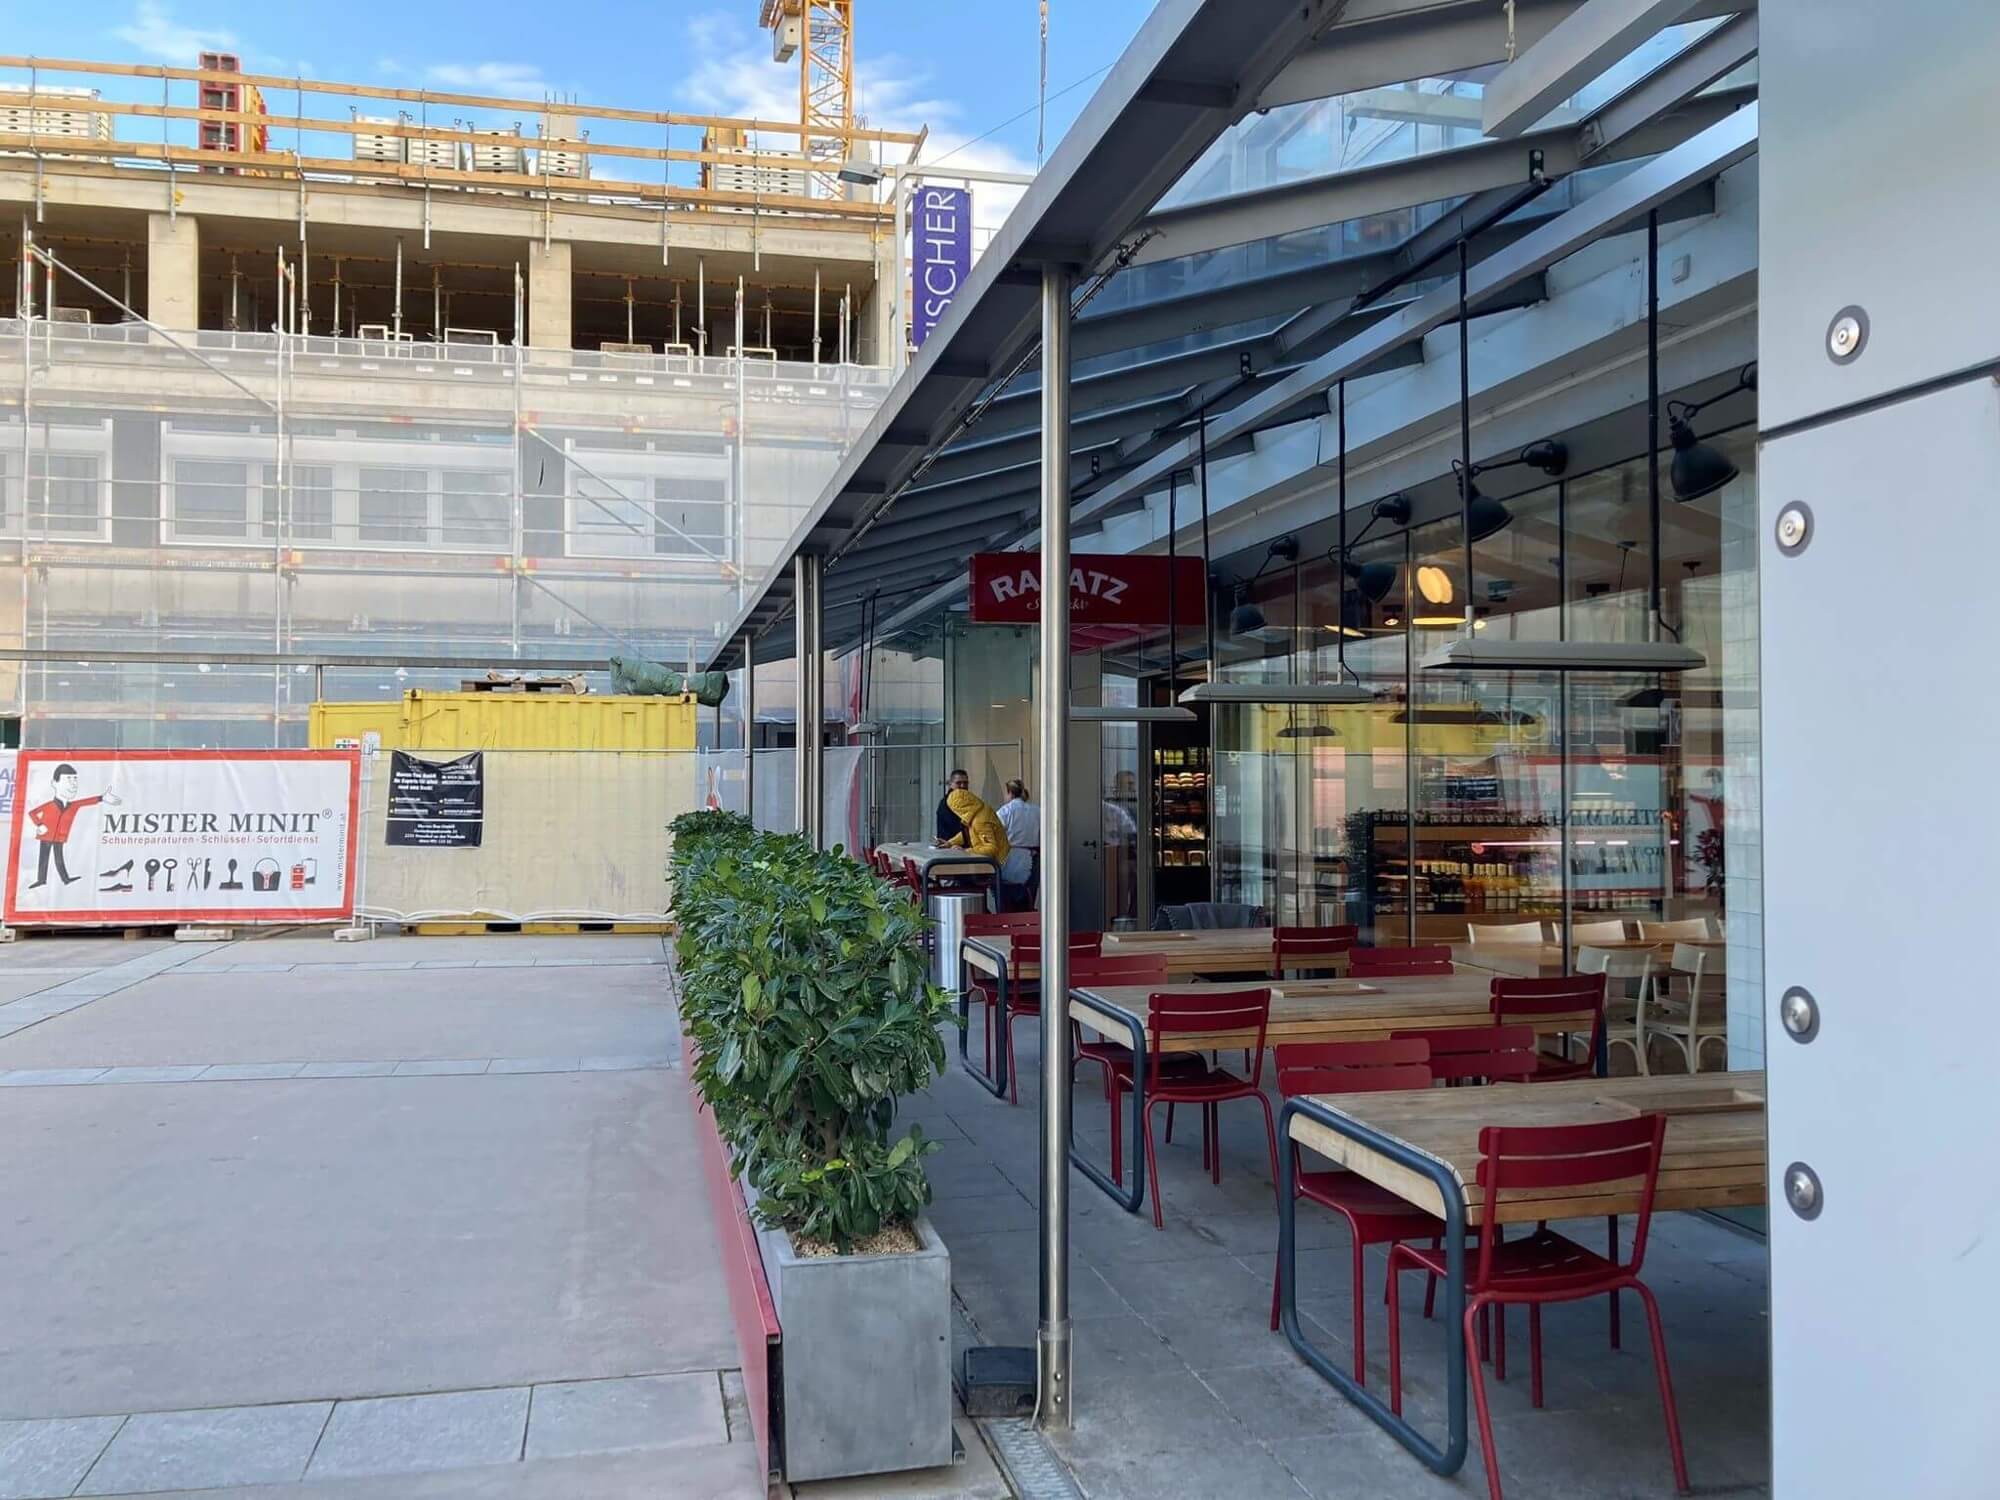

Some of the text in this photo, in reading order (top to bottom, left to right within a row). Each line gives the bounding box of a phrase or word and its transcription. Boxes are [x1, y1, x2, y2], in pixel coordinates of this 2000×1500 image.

[925, 191, 957, 337] SCHER
[989, 568, 1128, 604] RAATZ
[102, 813, 217, 834] MISTER
[102, 836, 194, 845] Schuhreparaturen
[257, 835, 319, 844] Sofortdienst
